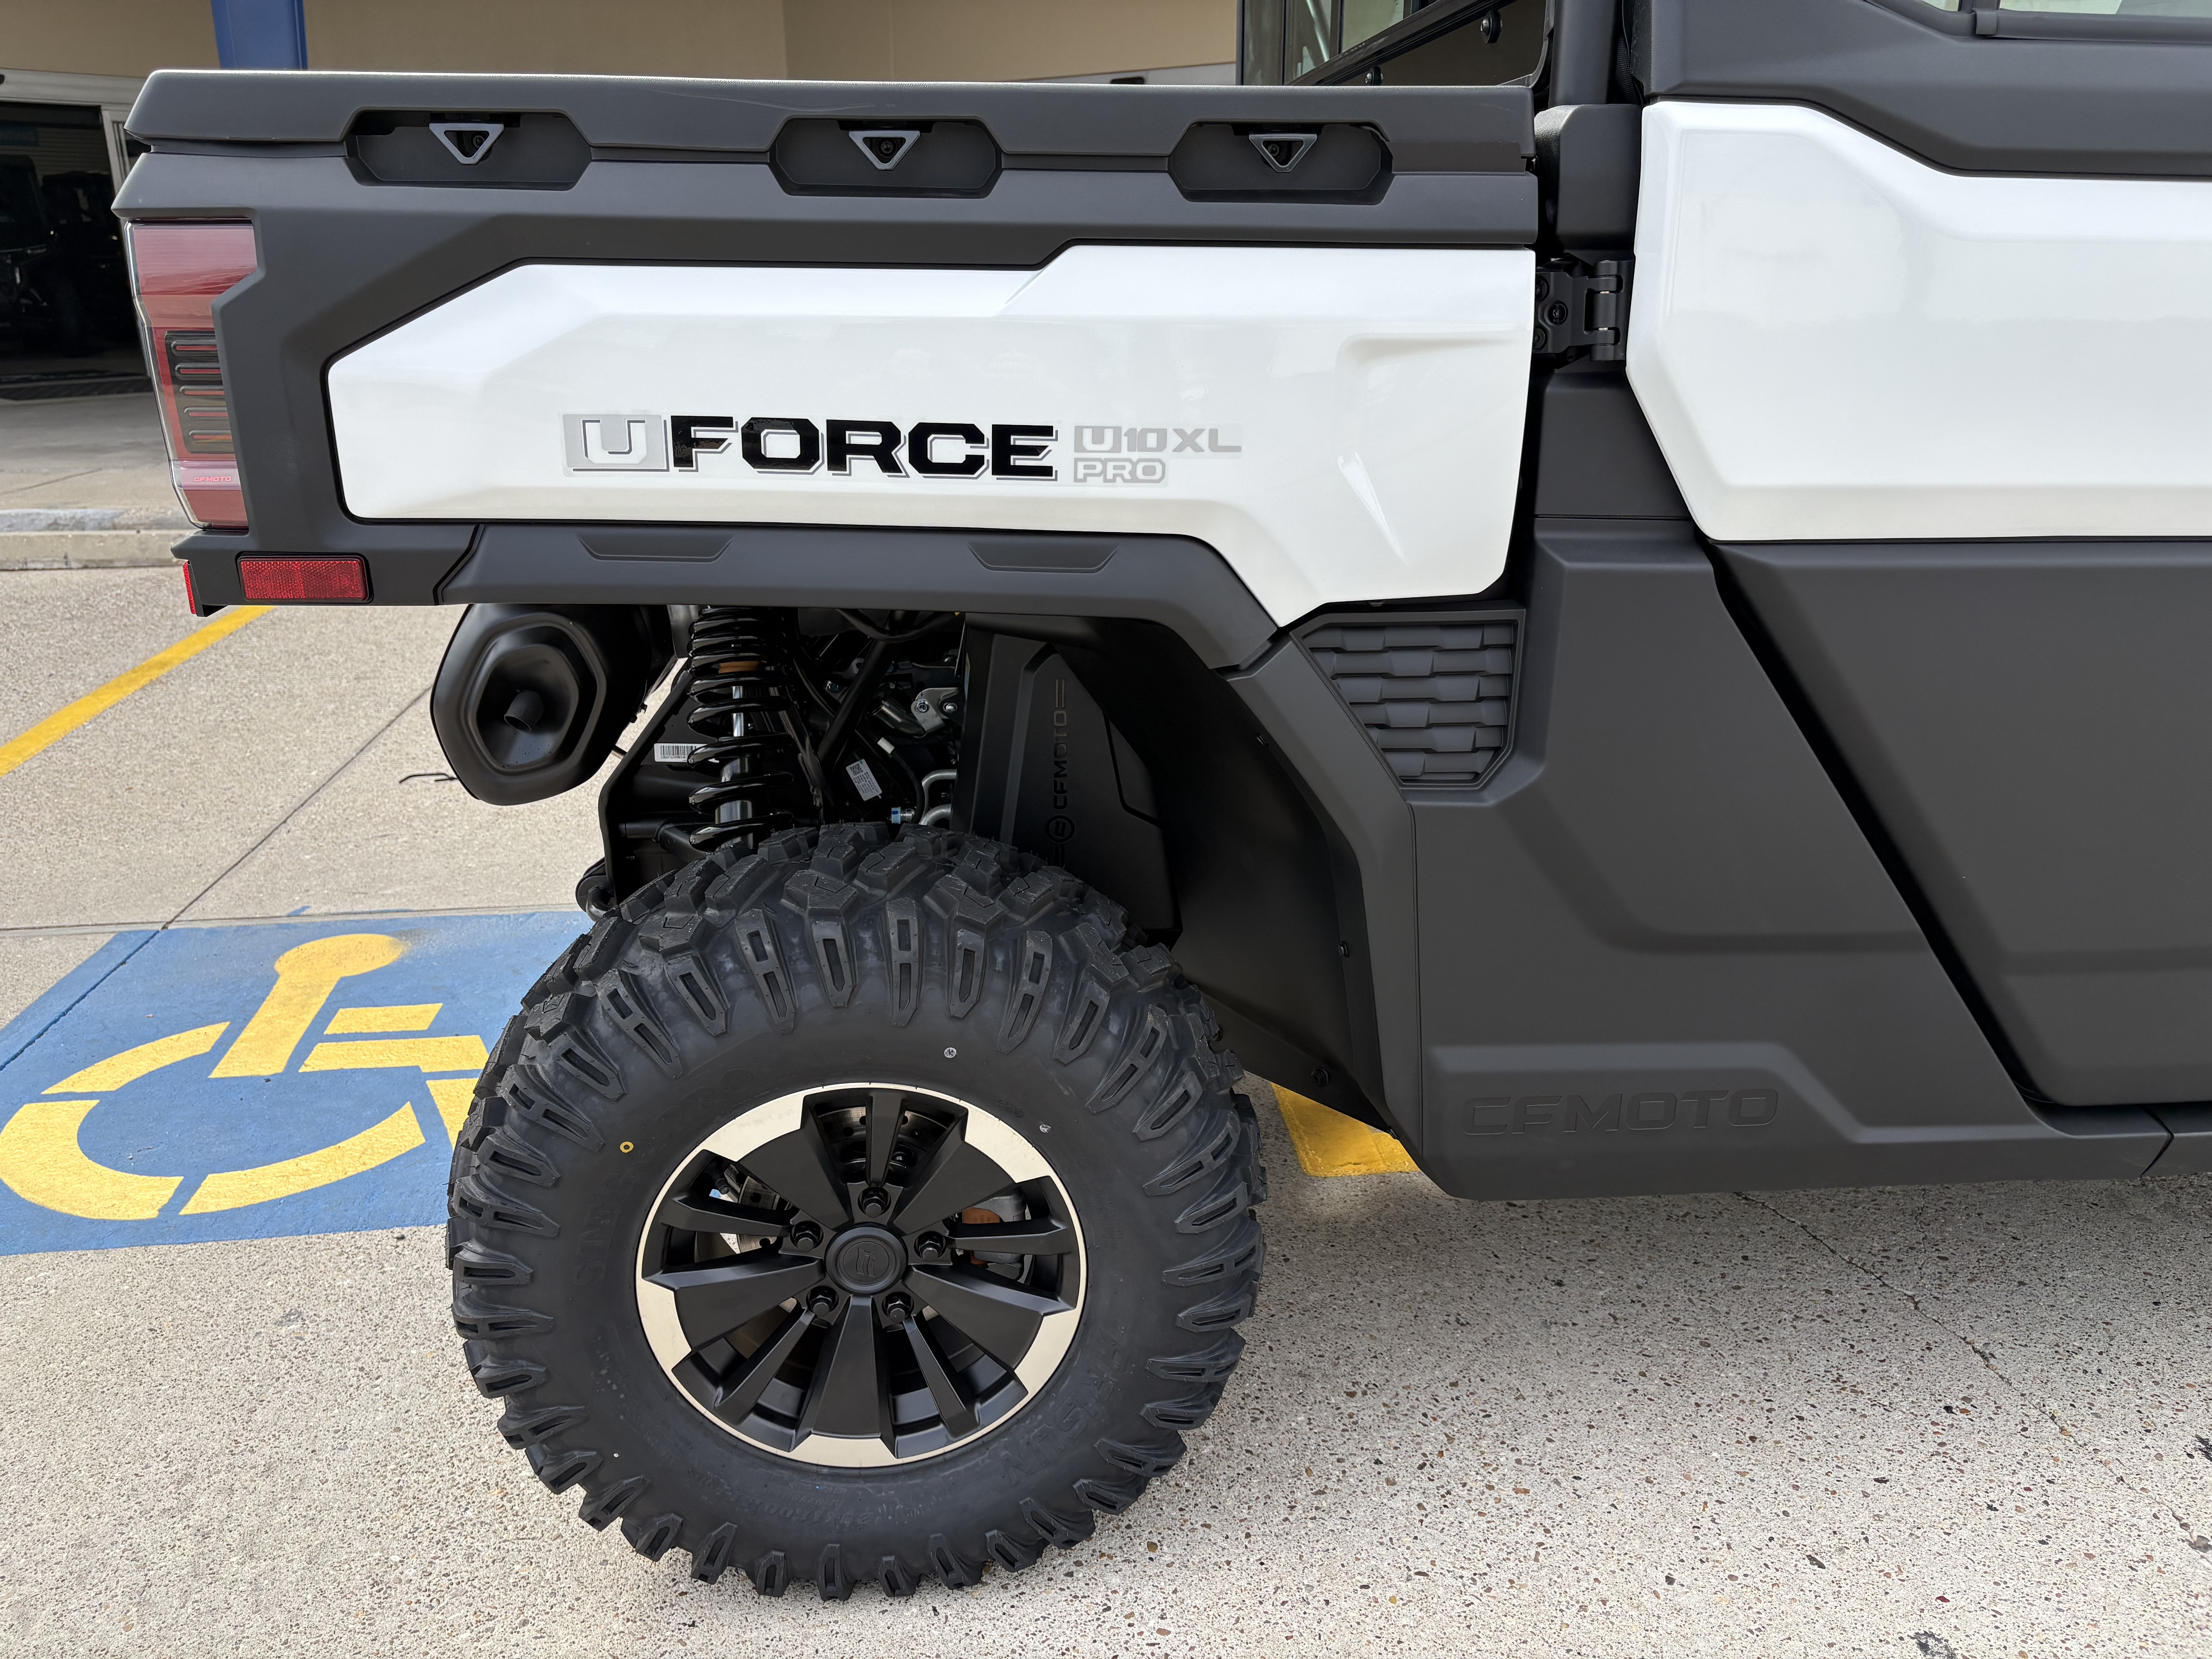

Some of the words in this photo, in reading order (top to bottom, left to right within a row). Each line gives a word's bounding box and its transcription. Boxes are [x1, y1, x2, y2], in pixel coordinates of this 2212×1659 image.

[1074, 458, 1166, 483] PRO
[1053, 710, 1068, 810] CFMOTO
[1462, 1089, 1778, 1135] CFMOTO
[1001, 1326, 1130, 1485] ARISUN
